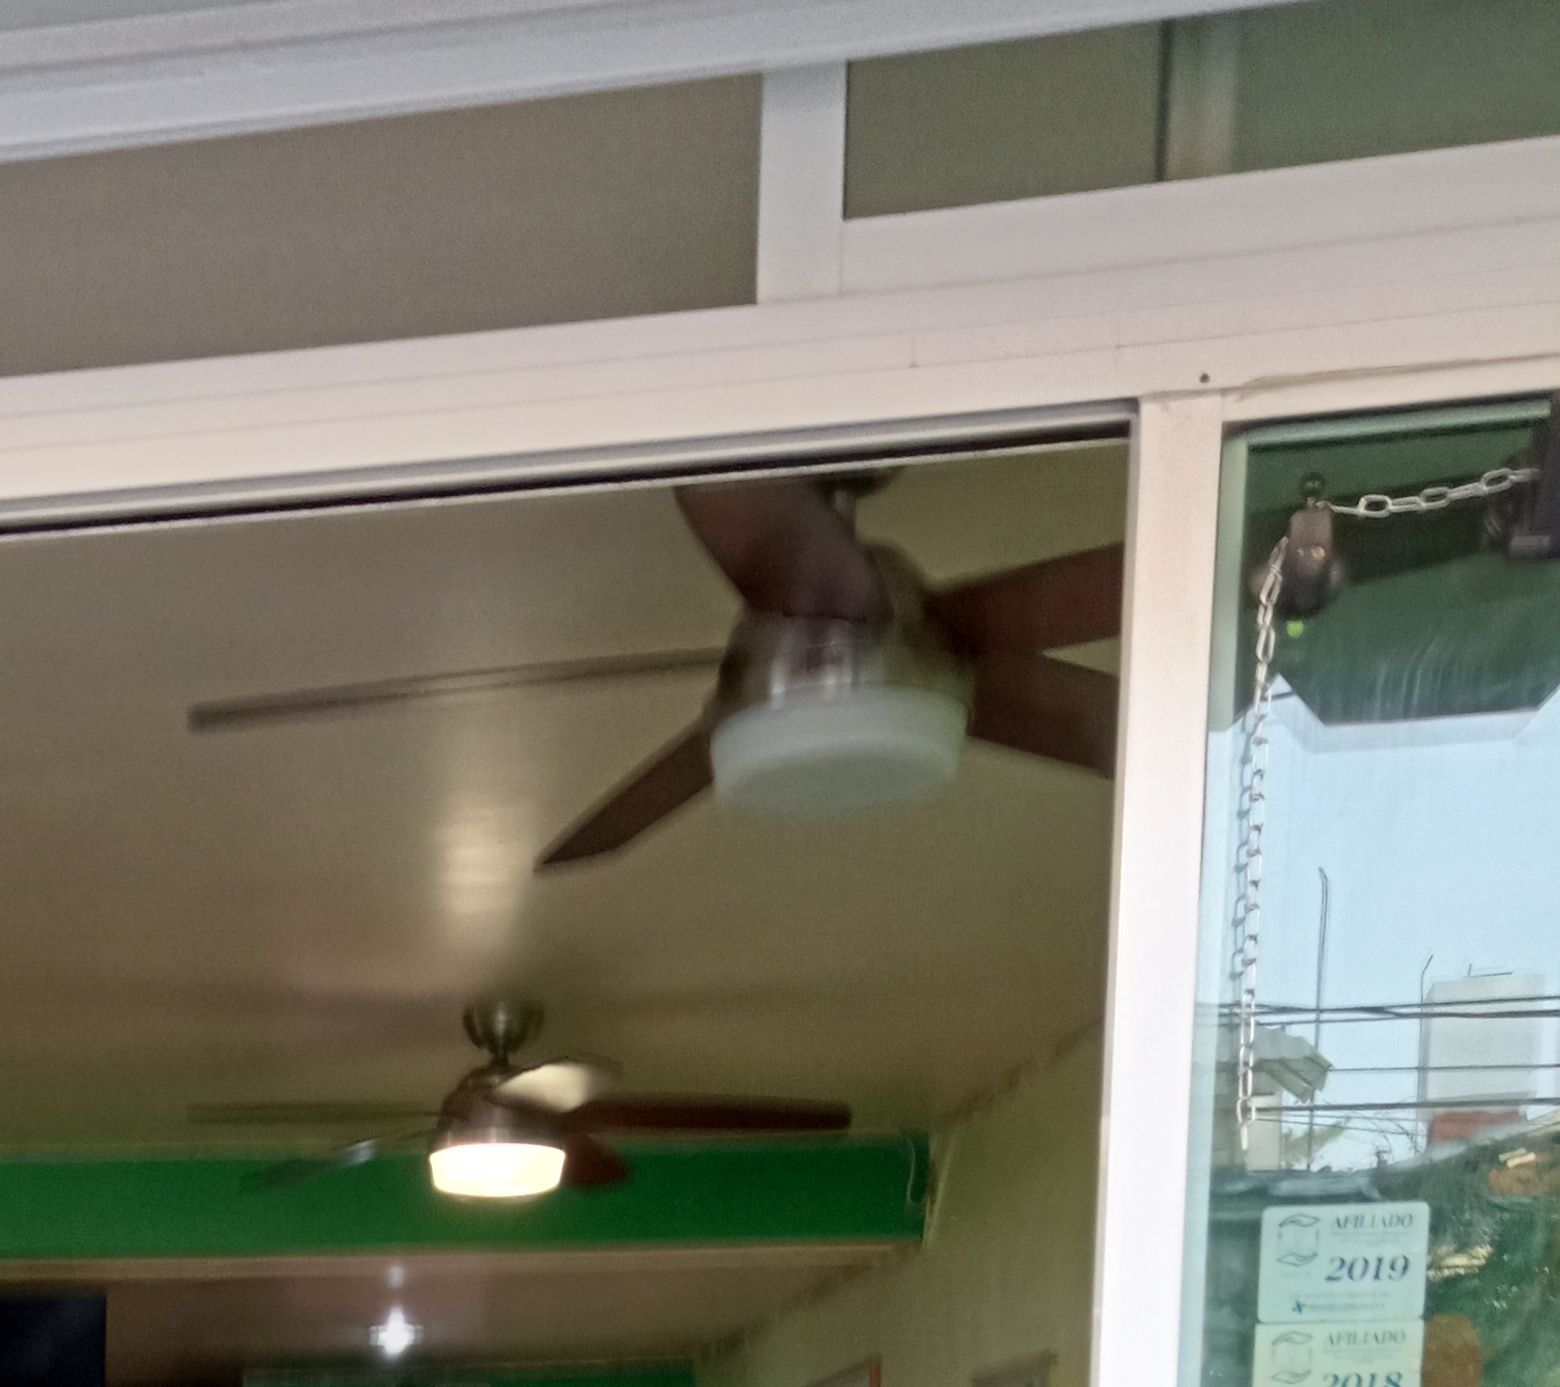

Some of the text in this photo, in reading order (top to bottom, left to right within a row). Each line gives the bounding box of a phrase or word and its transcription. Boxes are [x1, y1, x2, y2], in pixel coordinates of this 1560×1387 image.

[1333, 1213, 1414, 1229] AFILIADO
[1324, 1254, 1411, 1282] 2019
[1328, 1329, 1407, 1346] AFILIADO
